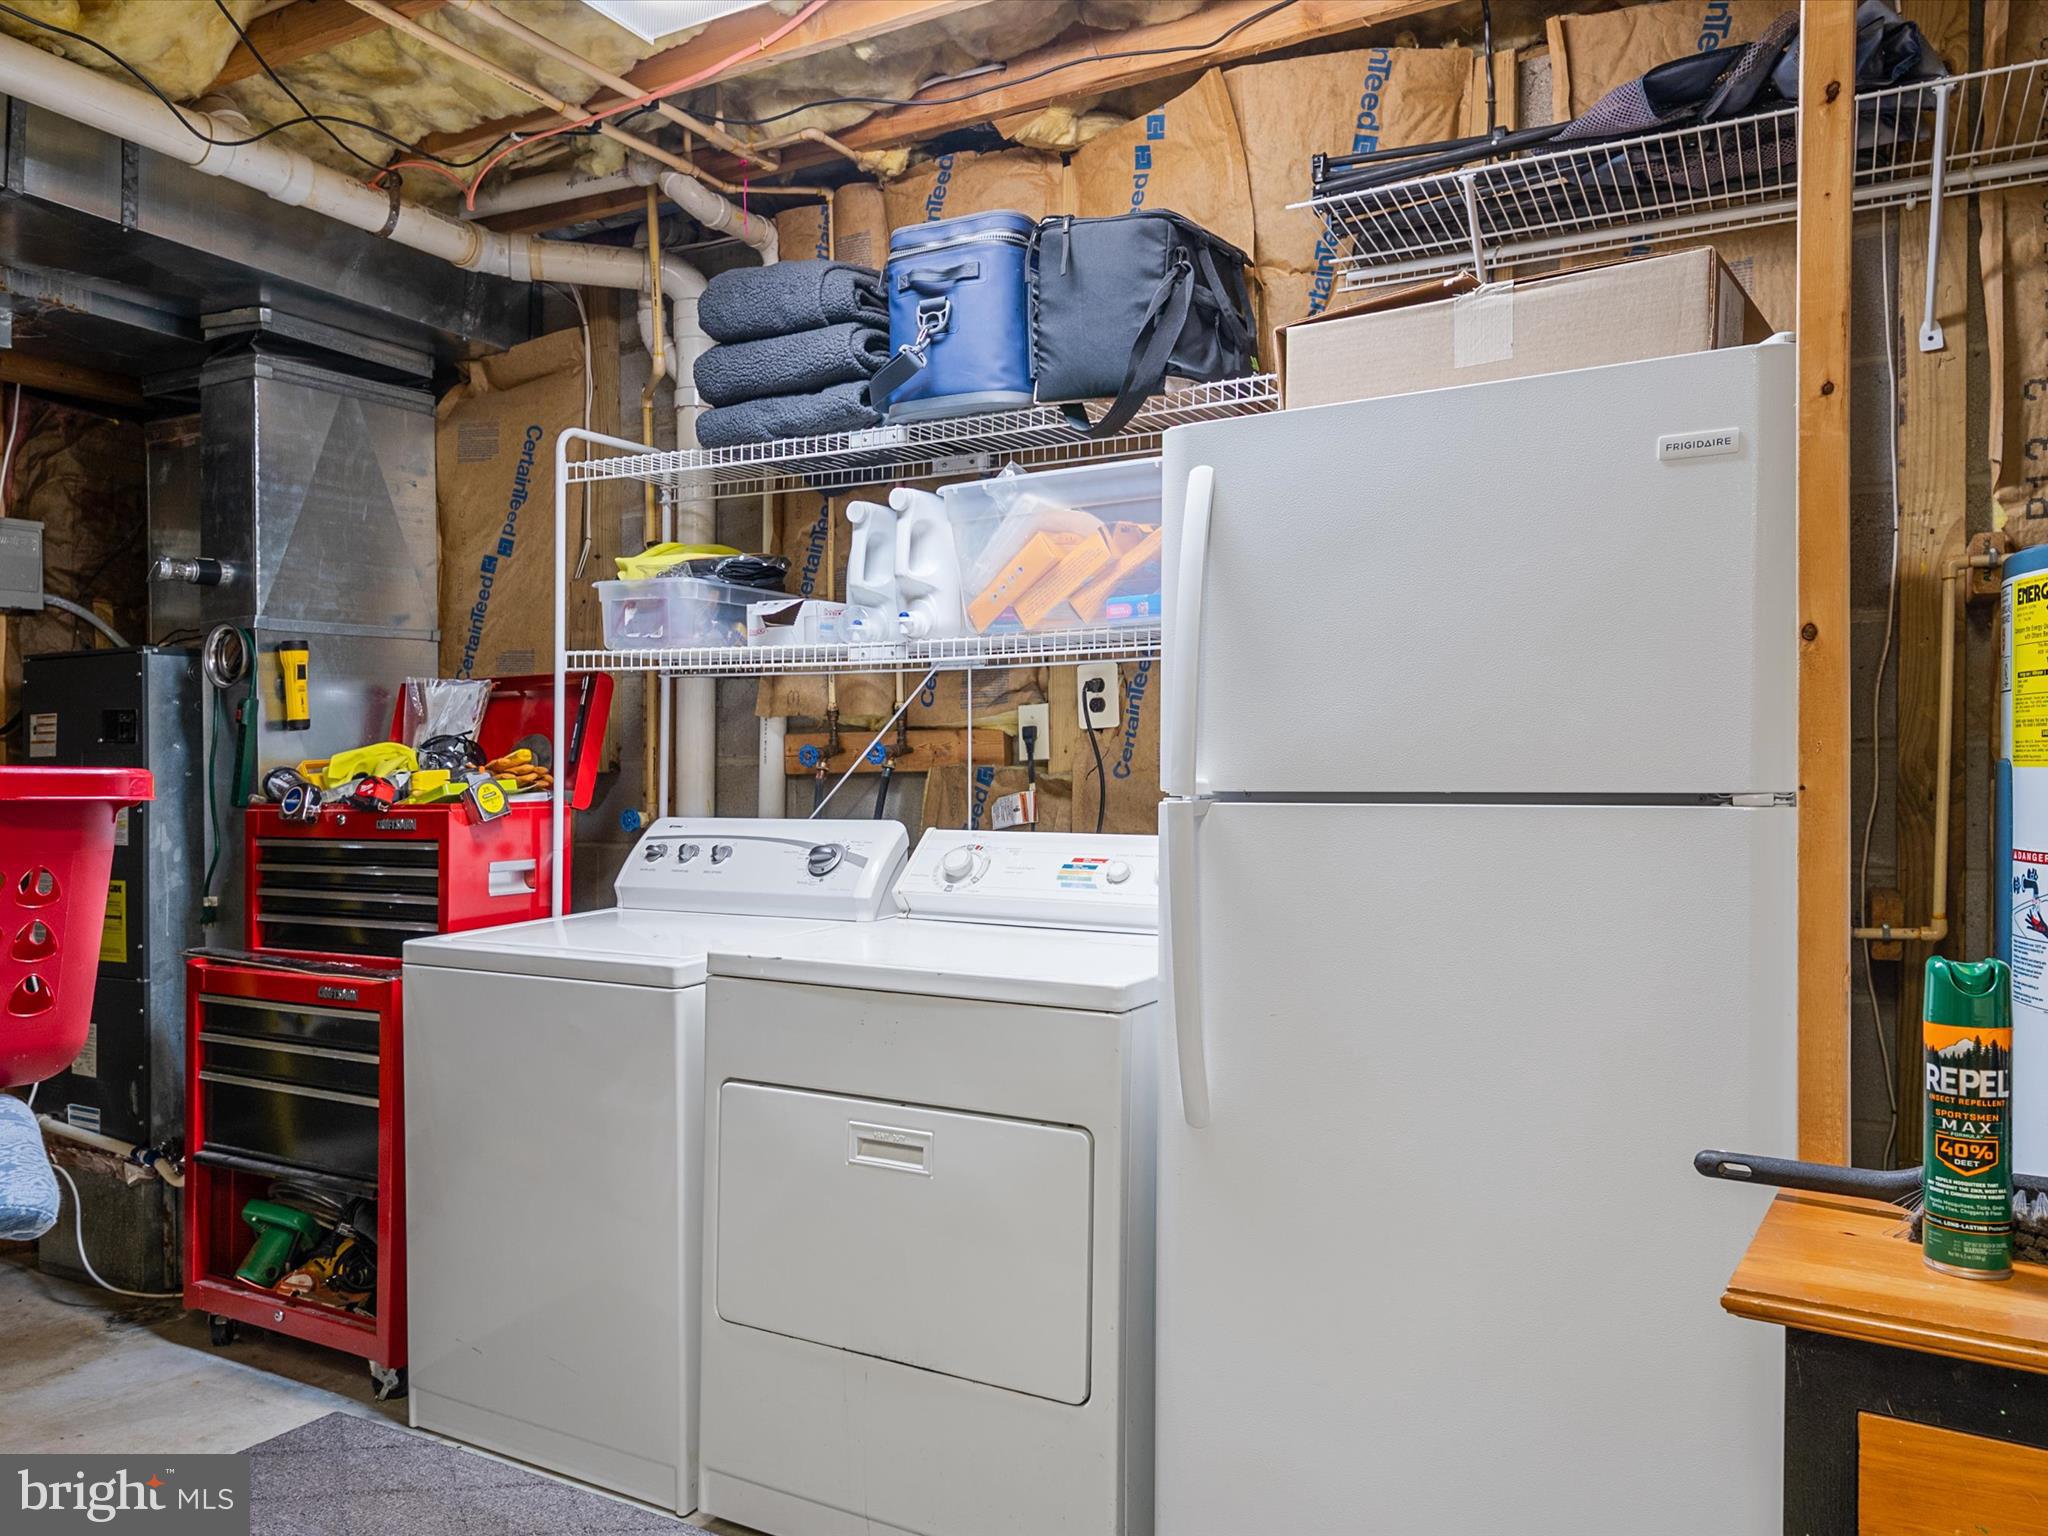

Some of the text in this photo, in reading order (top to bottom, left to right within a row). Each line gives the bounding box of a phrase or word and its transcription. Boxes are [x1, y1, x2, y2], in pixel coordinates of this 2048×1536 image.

[1665, 437, 1732, 452] FRIGIDAIRE
[501, 425, 543, 538] CertainTeed
[456, 573, 494, 680] CertainTeed
[1926, 1062, 2009, 1098] REPEL
[1929, 1093, 2005, 1107] INSECT REPELLENT
[1935, 1108, 2000, 1121] SPORTSMEN
[1942, 1117, 1992, 1134] MAX
[1940, 1140, 1993, 1160] 40%
[1954, 1159, 1980, 1167] DEET
[1943, 1220, 1988, 1231] LONG-LASTING
